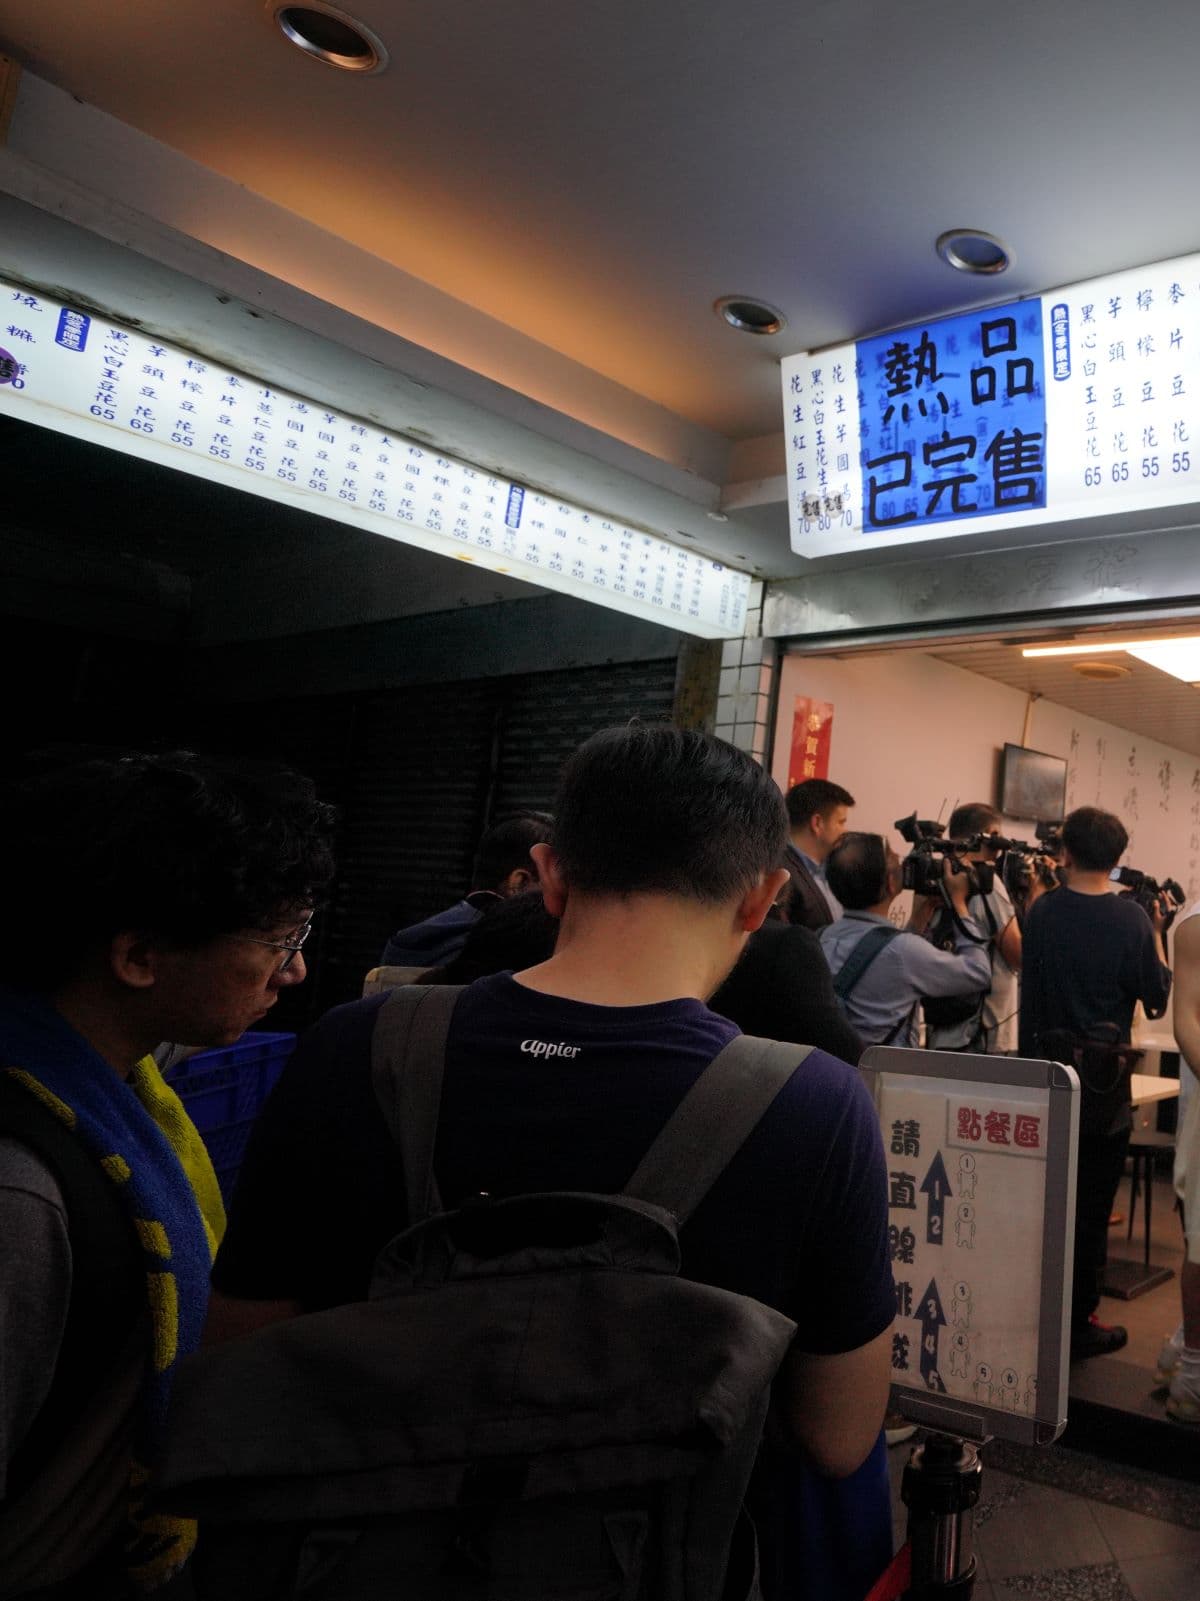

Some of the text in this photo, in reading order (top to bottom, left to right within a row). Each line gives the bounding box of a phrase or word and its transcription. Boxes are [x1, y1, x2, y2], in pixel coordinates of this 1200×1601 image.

[883, 317, 1035, 424] 熱品
[1136, 290, 1159, 477] 檸檬豆花 55
[1168, 283, 1190, 473] 麥片豆花 55
[1080, 304, 1101, 486] 黑心白玉豆花 65
[1108, 297, 1129, 482] 芋頭豆花 65
[90, 405, 115, 420] 65
[130, 419, 154, 433] 65
[171, 433, 193, 447] 55
[209, 445, 230, 459] 55
[244, 458, 265, 471] 55
[277, 469, 296, 482] 55
[867, 428, 1043, 527] 已完售
[309, 479, 327, 492] 55
[339, 490, 356, 502] 55
[369, 500, 386, 512] 55
[397, 510, 413, 521] 55
[840, 510, 852, 526] 70
[426, 520, 441, 531] 55
[453, 528, 468, 540] 55
[477, 537, 492, 548] 55
[957, 1107, 1040, 1148] 點餐區
[931, 1215, 941, 1235] 2
[927, 1299, 937, 1319] 3
[925, 1334, 935, 1355] 4
